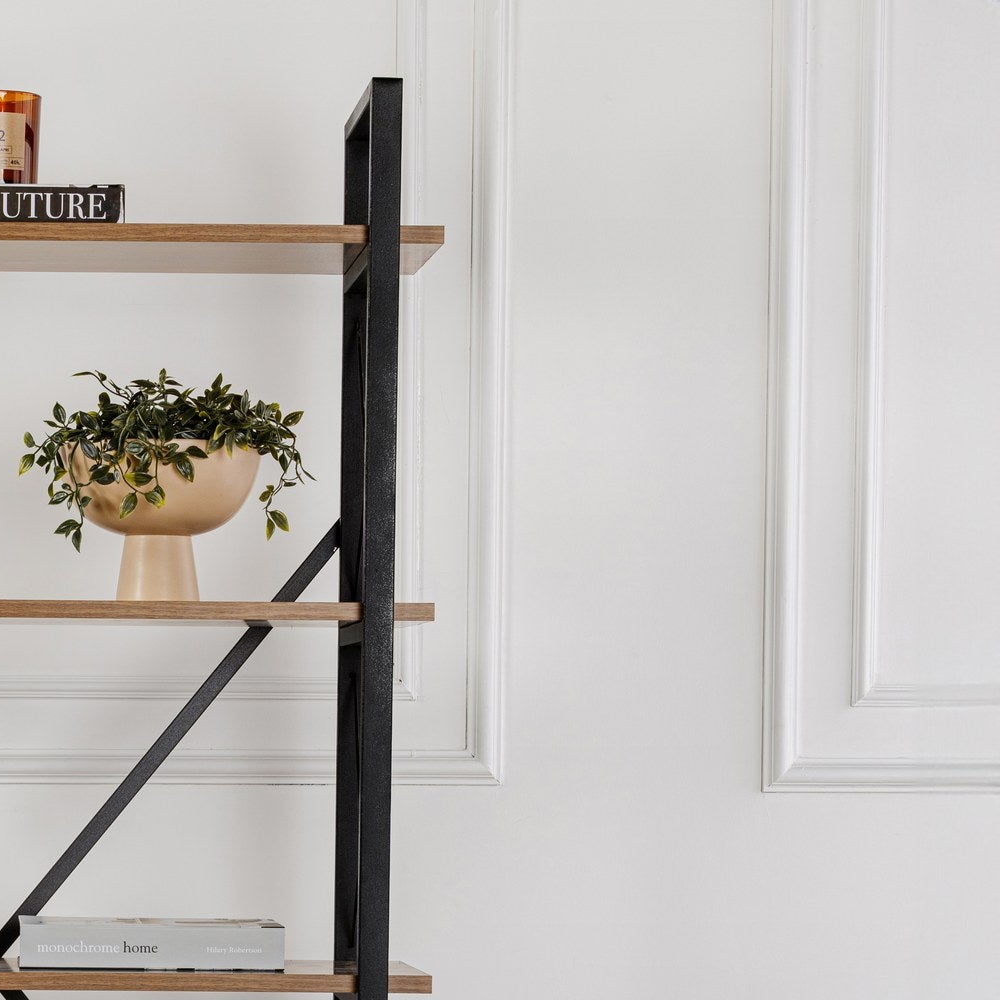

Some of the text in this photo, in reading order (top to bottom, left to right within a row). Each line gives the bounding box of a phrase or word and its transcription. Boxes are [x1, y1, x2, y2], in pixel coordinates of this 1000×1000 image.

[37, 940, 158, 954] monochrome home
[228, 946, 263, 954] Robertson
